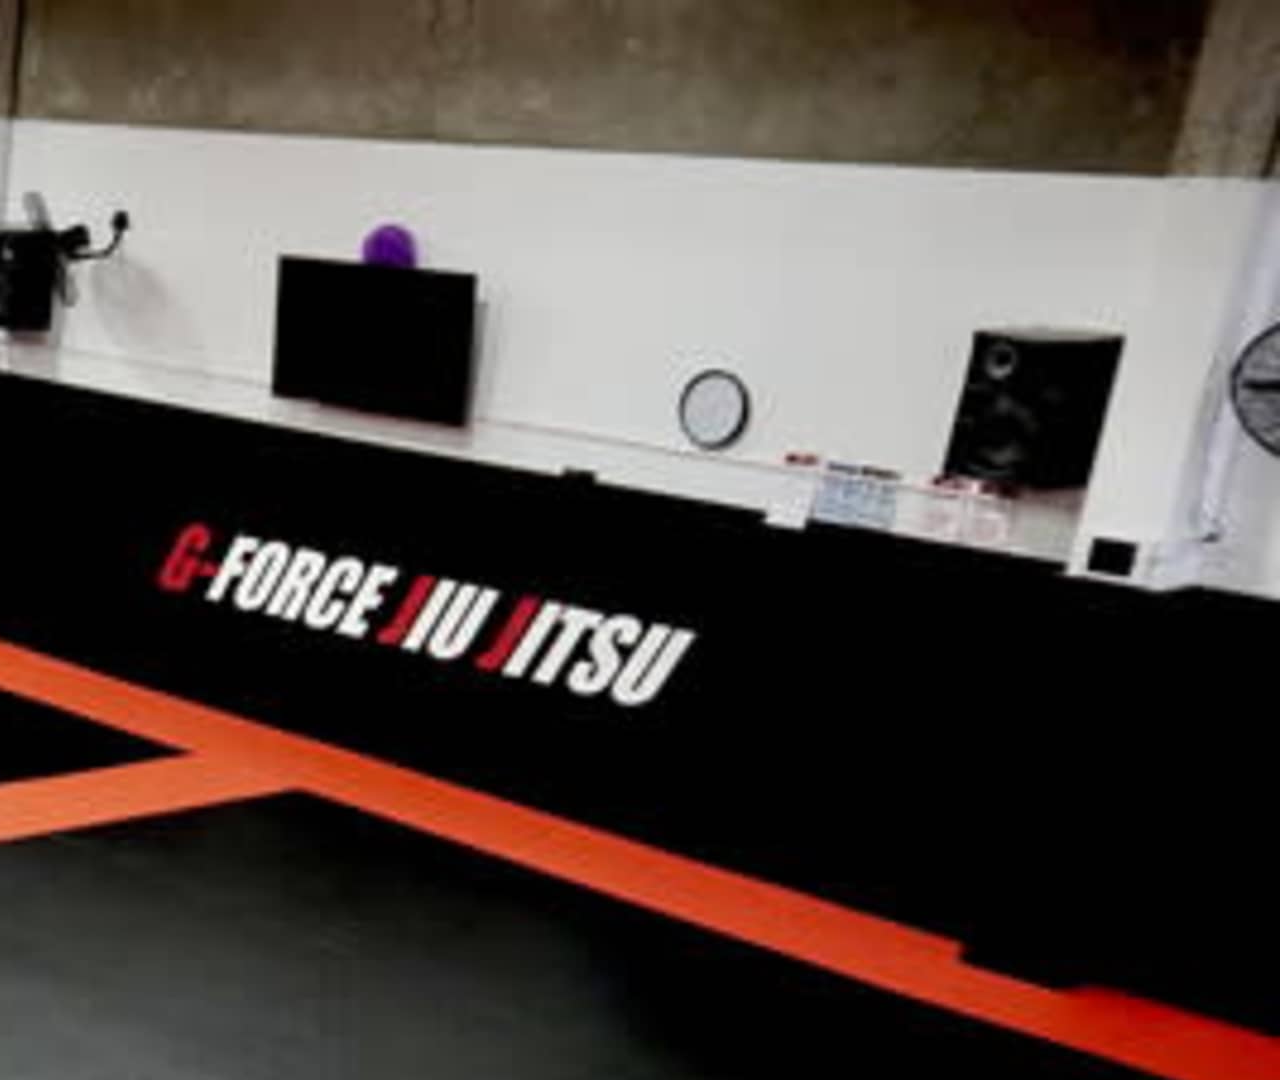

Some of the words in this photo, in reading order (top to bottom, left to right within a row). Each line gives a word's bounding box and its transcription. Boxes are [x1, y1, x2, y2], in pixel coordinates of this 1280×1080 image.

[157, 522, 400, 640] G-FORCE
[377, 574, 501, 661] JIU
[474, 593, 697, 707] JITSU
